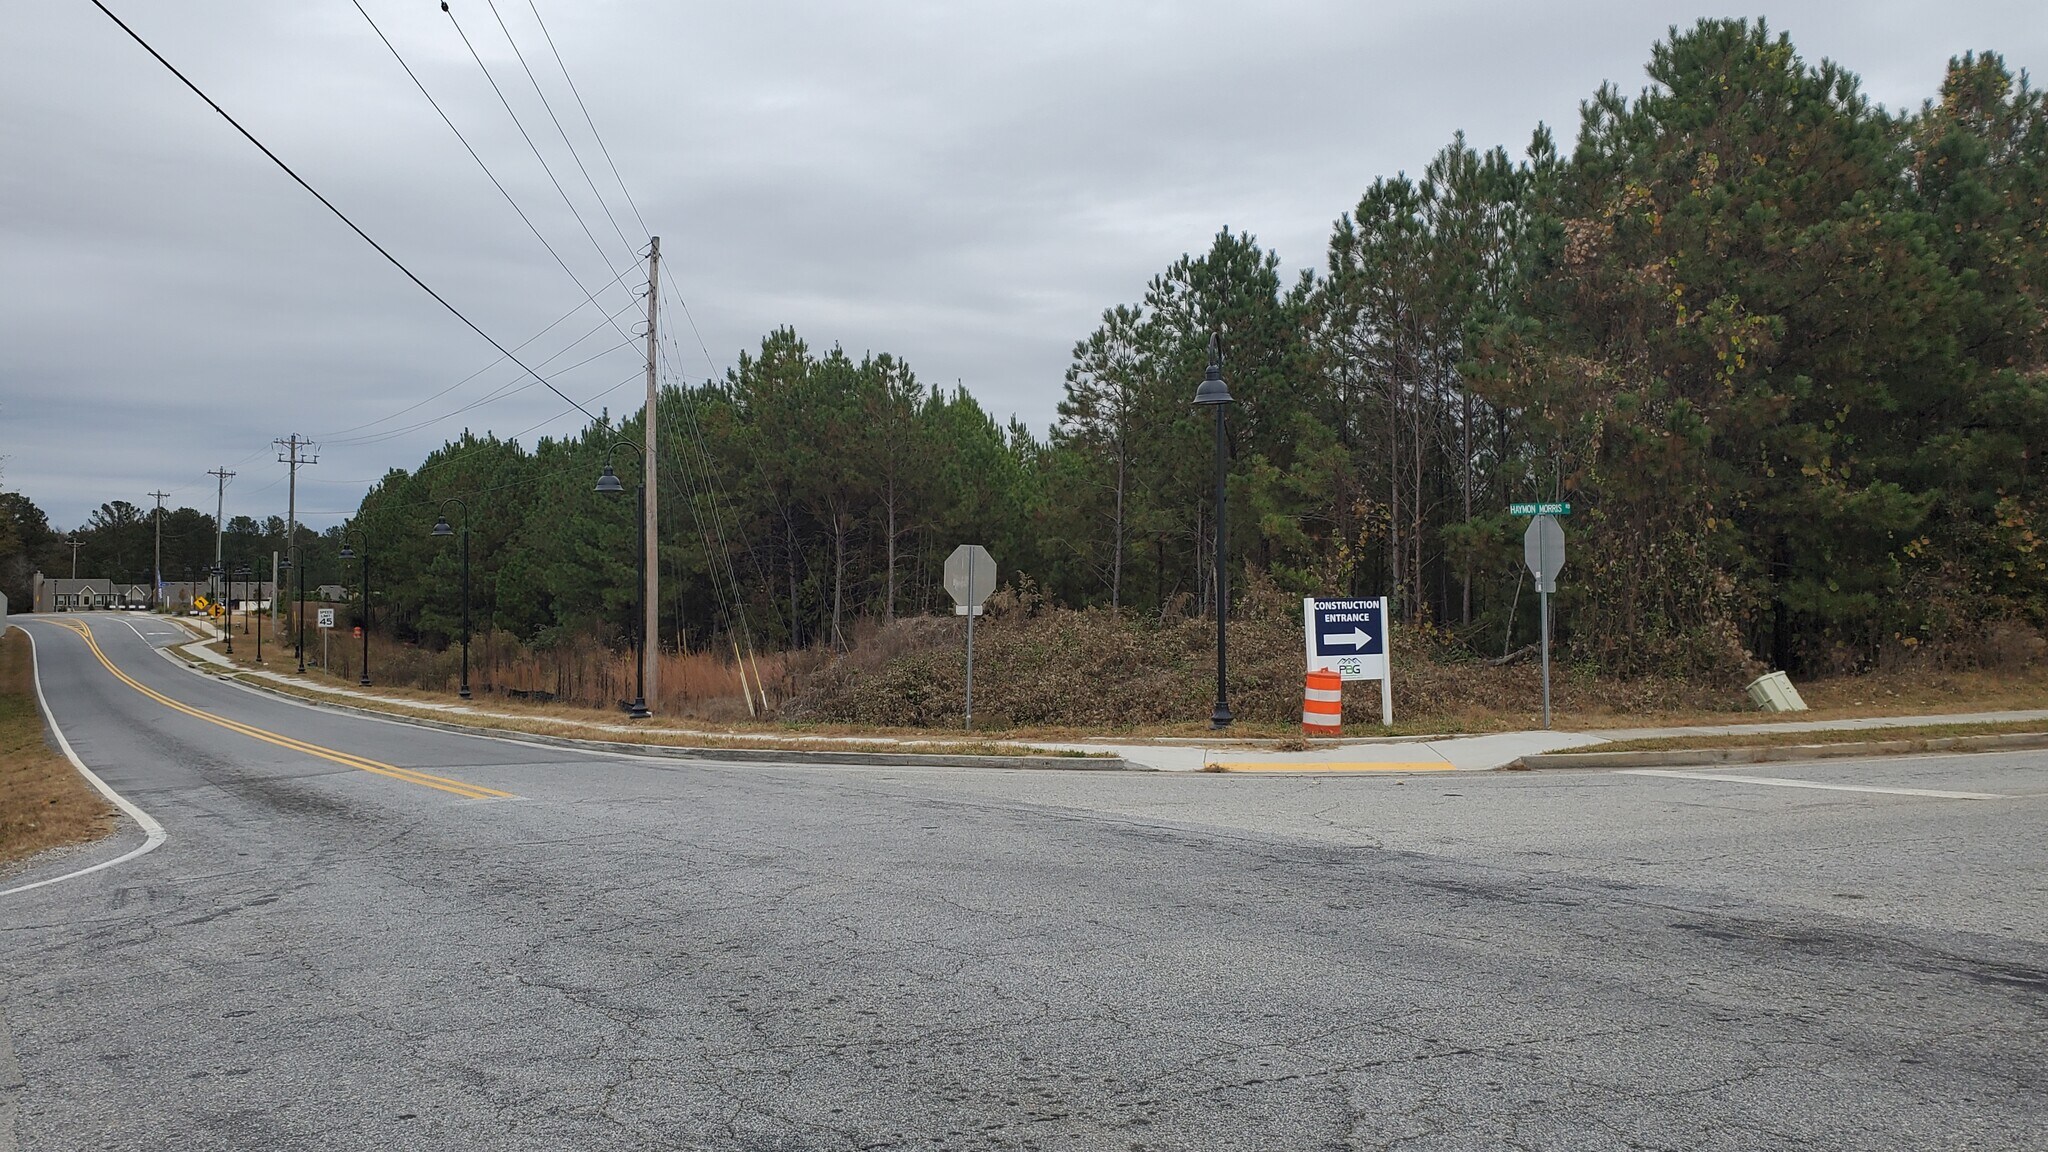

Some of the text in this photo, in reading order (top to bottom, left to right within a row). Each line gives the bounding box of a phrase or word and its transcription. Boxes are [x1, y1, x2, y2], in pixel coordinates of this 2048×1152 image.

[1510, 504, 1536, 514] HAYMON
[1539, 503, 1562, 513] MORRIS
[1314, 601, 1379, 610] CONSTRUCTION
[1324, 613, 1370, 623] ENTRANCE
